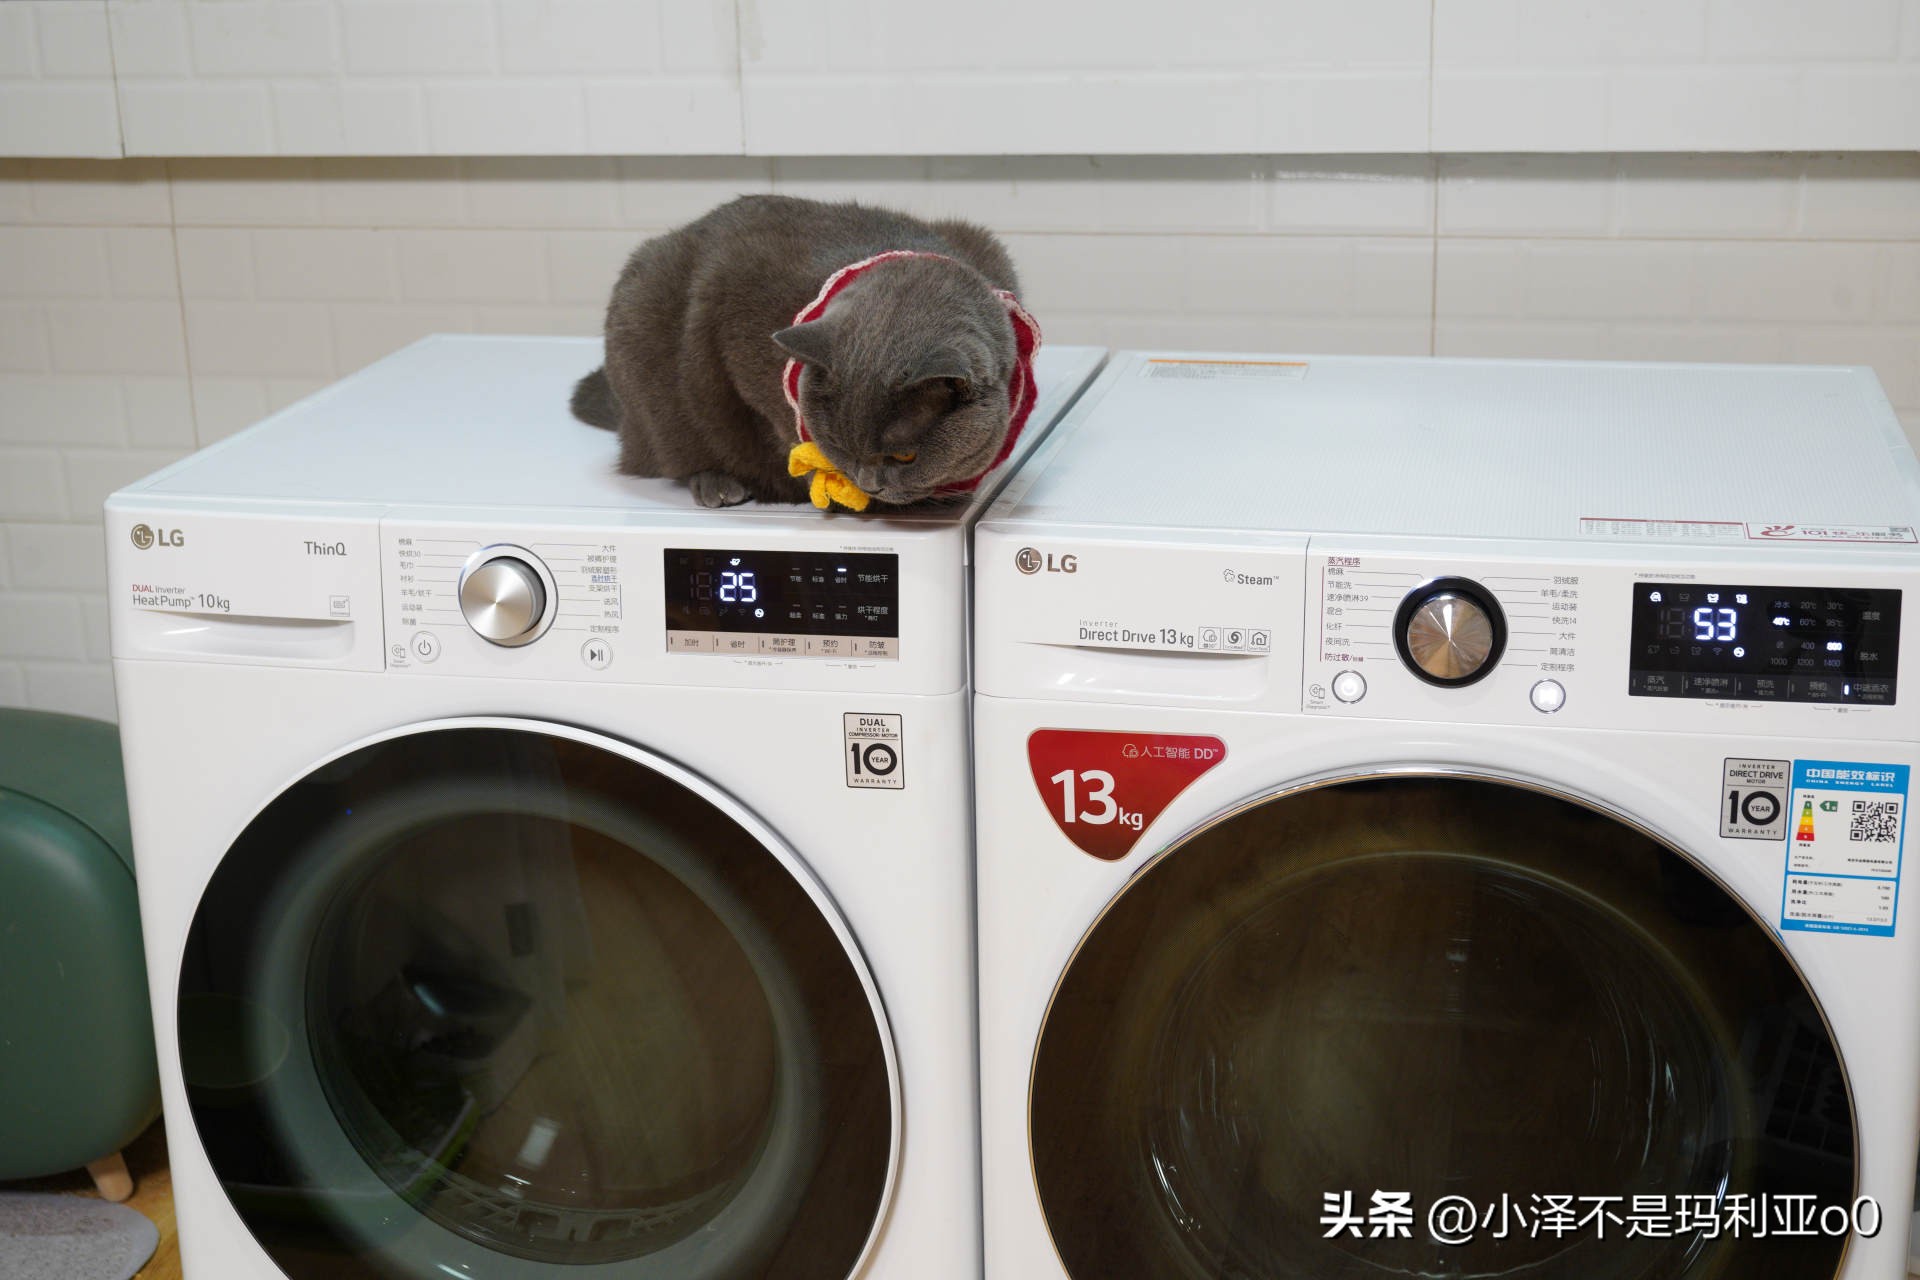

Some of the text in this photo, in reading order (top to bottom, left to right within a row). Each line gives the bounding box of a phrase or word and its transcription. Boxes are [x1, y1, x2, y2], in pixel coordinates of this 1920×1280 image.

[158, 528, 185, 547] LG
[304, 541, 348, 556] ThinQ
[1047, 554, 1078, 573] LG
[1328, 556, 1360, 566] 蒸汽程序
[857, 574, 888, 583] 节能烘干
[132, 584, 185, 594] DUAL Inverter
[720, 572, 756, 602] 25
[1328, 580, 1352, 589] 节能洗
[857, 606, 888, 614] 烘干程度
[1552, 602, 1577, 611] 运动装
[1079, 619, 1118, 627] Inverter
[1694, 608, 1736, 641] 53
[1079, 628, 1118, 642] Direct
[1122, 629, 1156, 644] Drive
[1559, 632, 1576, 640] 大件
[823, 640, 838, 648] 预约
[1801, 642, 1815, 650] 400
[1770, 658, 1840, 667] 1000 1200 1400
[860, 718, 886, 726] DUAL
[1140, 746, 1190, 759] 人工智能
[851, 742, 898, 776] 10
[871, 756, 888, 764] YEAR
[1730, 770, 1784, 779] DIRECT DRIVE
[1806, 768, 1896, 782] 中国能效标识
[1729, 790, 1780, 826] 10
[1751, 804, 1770, 812] YEAR
